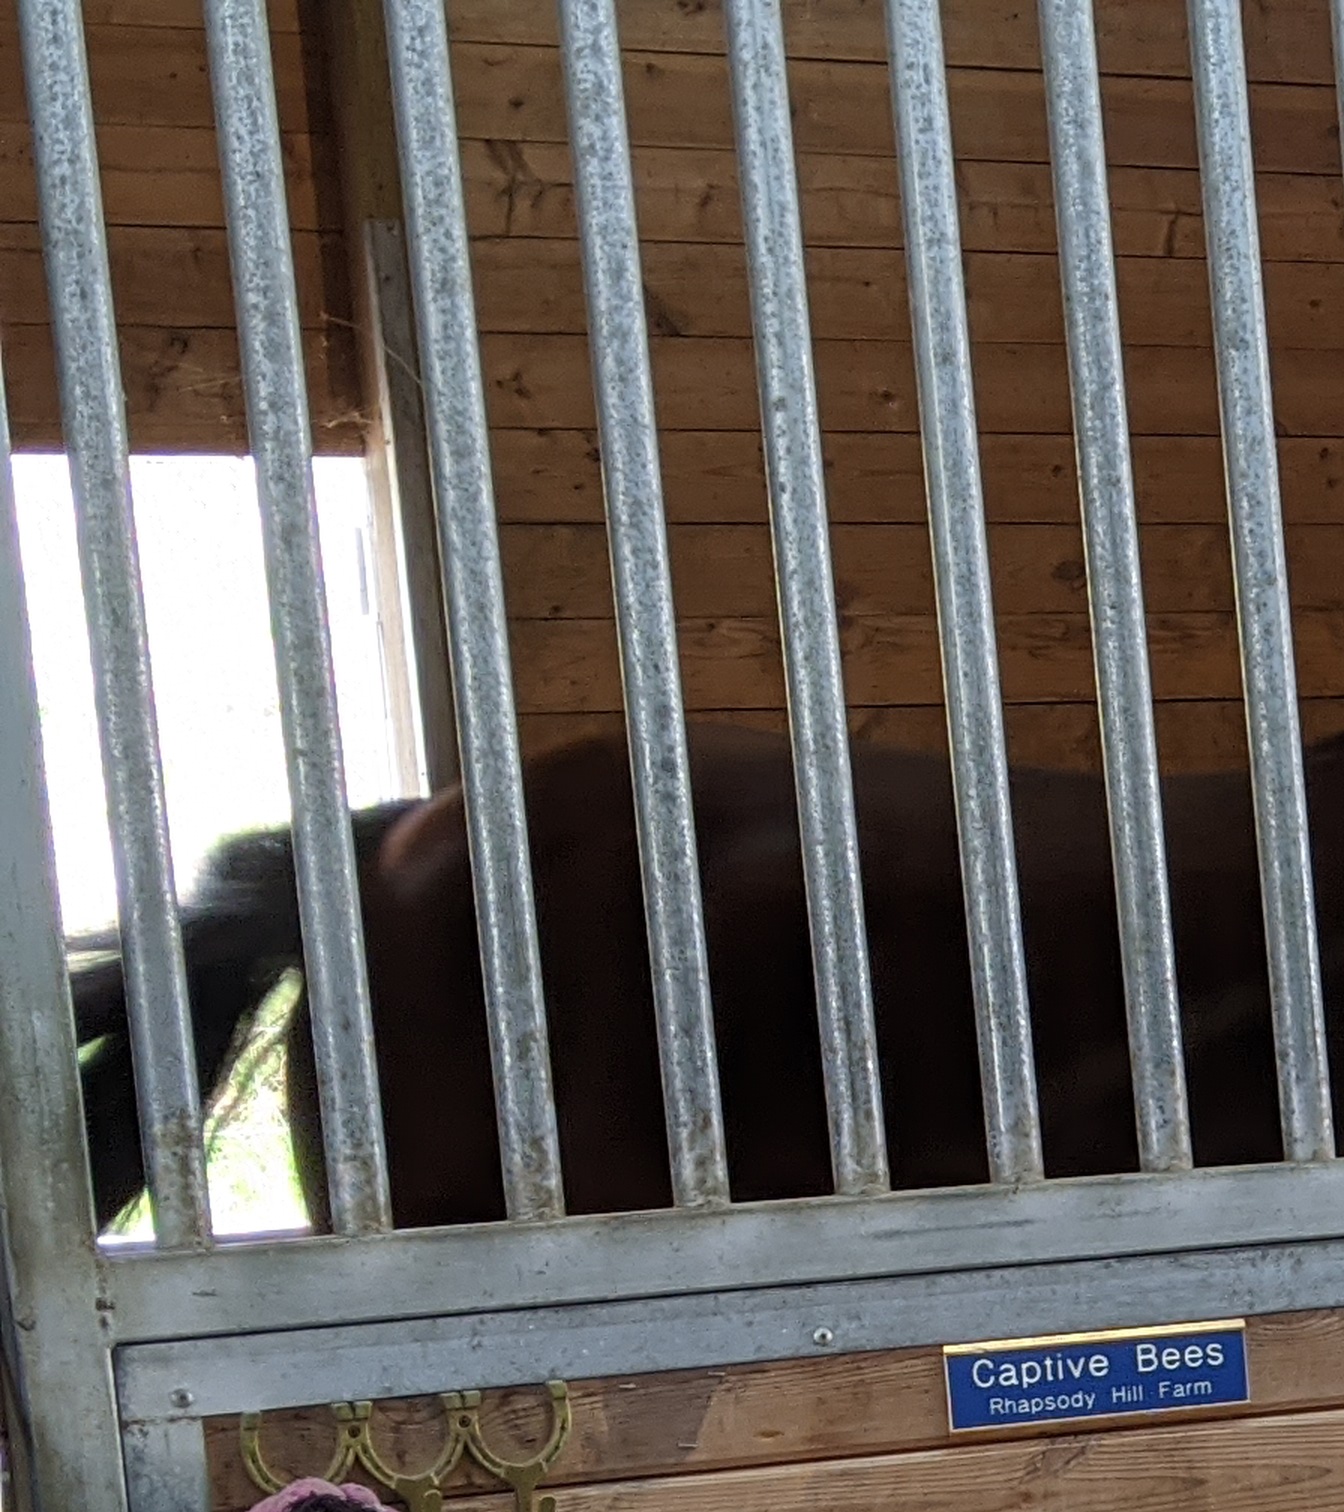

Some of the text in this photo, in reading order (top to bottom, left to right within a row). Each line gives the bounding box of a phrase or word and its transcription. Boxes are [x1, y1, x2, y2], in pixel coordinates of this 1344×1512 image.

[972, 1342, 1225, 1390] Captive Bees
[990, 1379, 1213, 1416] Rhapsody Hill Farm
